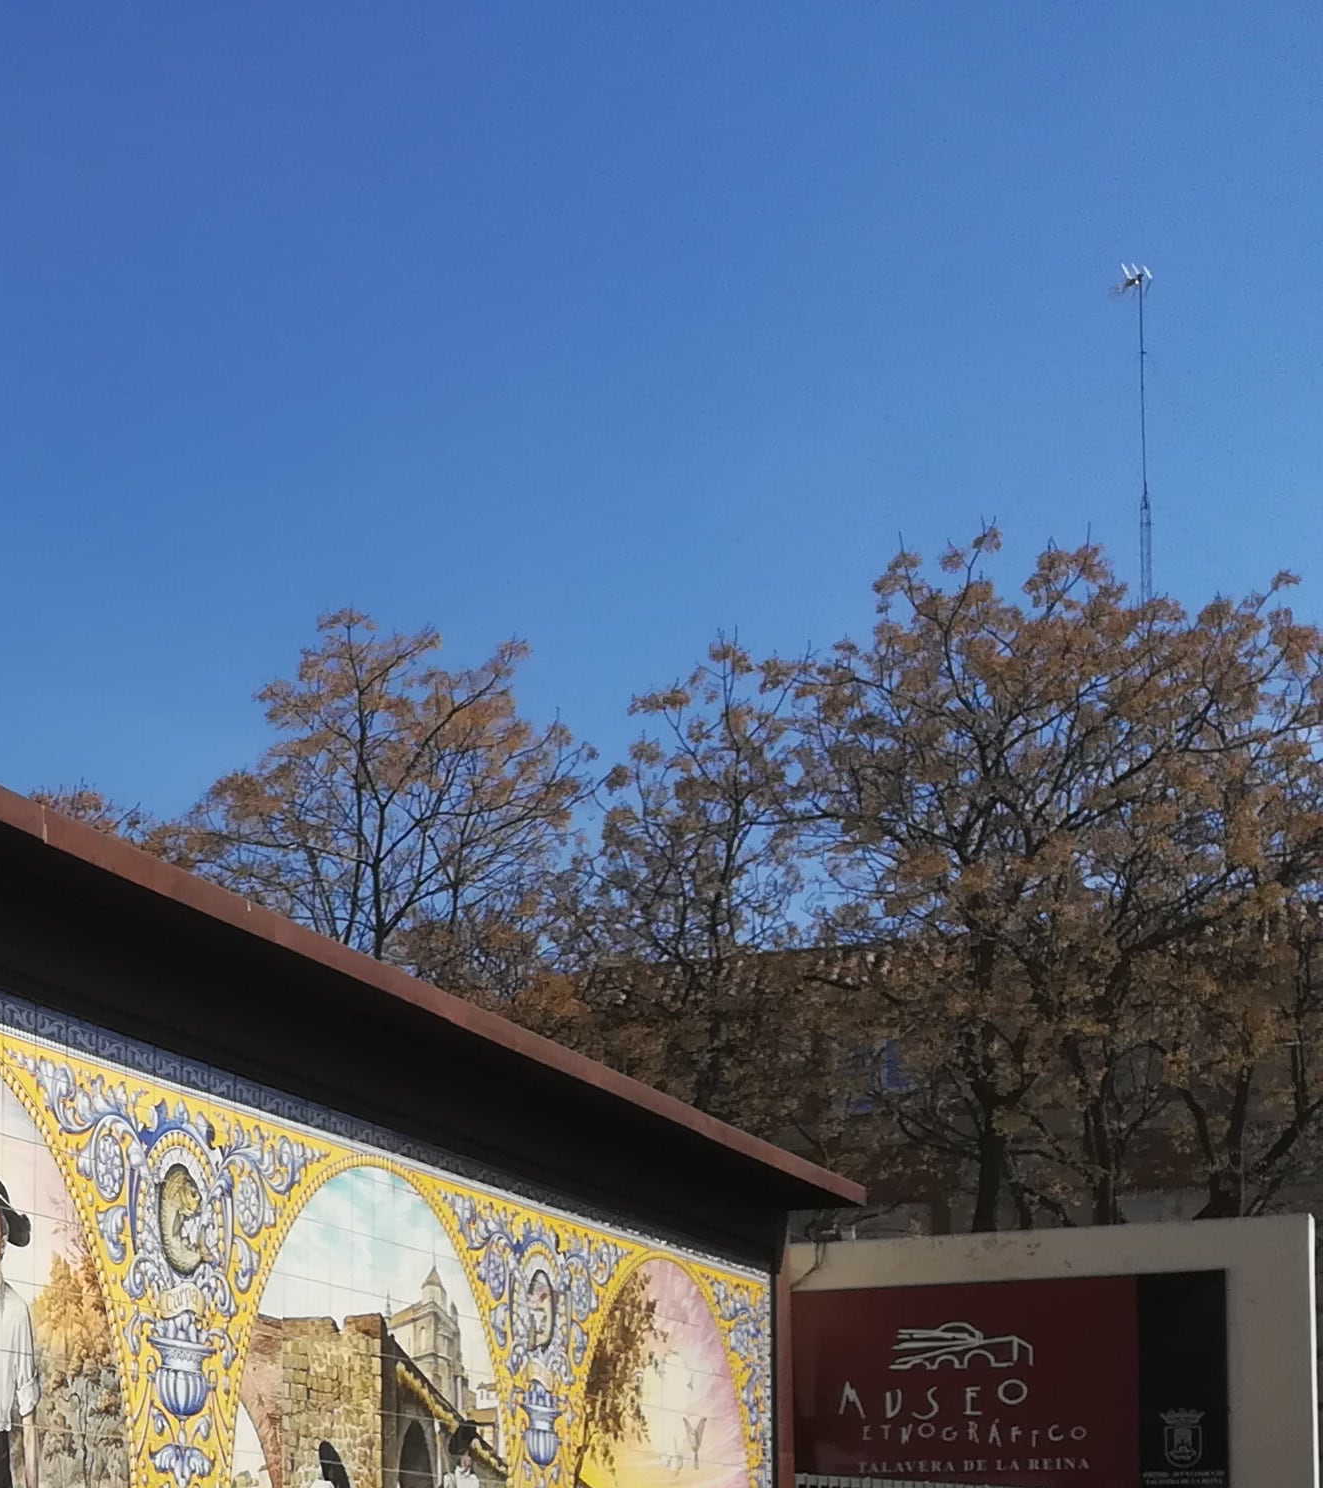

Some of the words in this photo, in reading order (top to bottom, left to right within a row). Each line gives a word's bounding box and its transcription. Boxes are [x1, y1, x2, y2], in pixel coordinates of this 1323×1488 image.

[838, 1379, 1028, 1420] MUSEO
[858, 1461, 955, 1474] TALAVERA
[963, 1459, 987, 1472] DE
[995, 1459, 1020, 1471] LA
[1028, 1457, 1090, 1471] REINA
